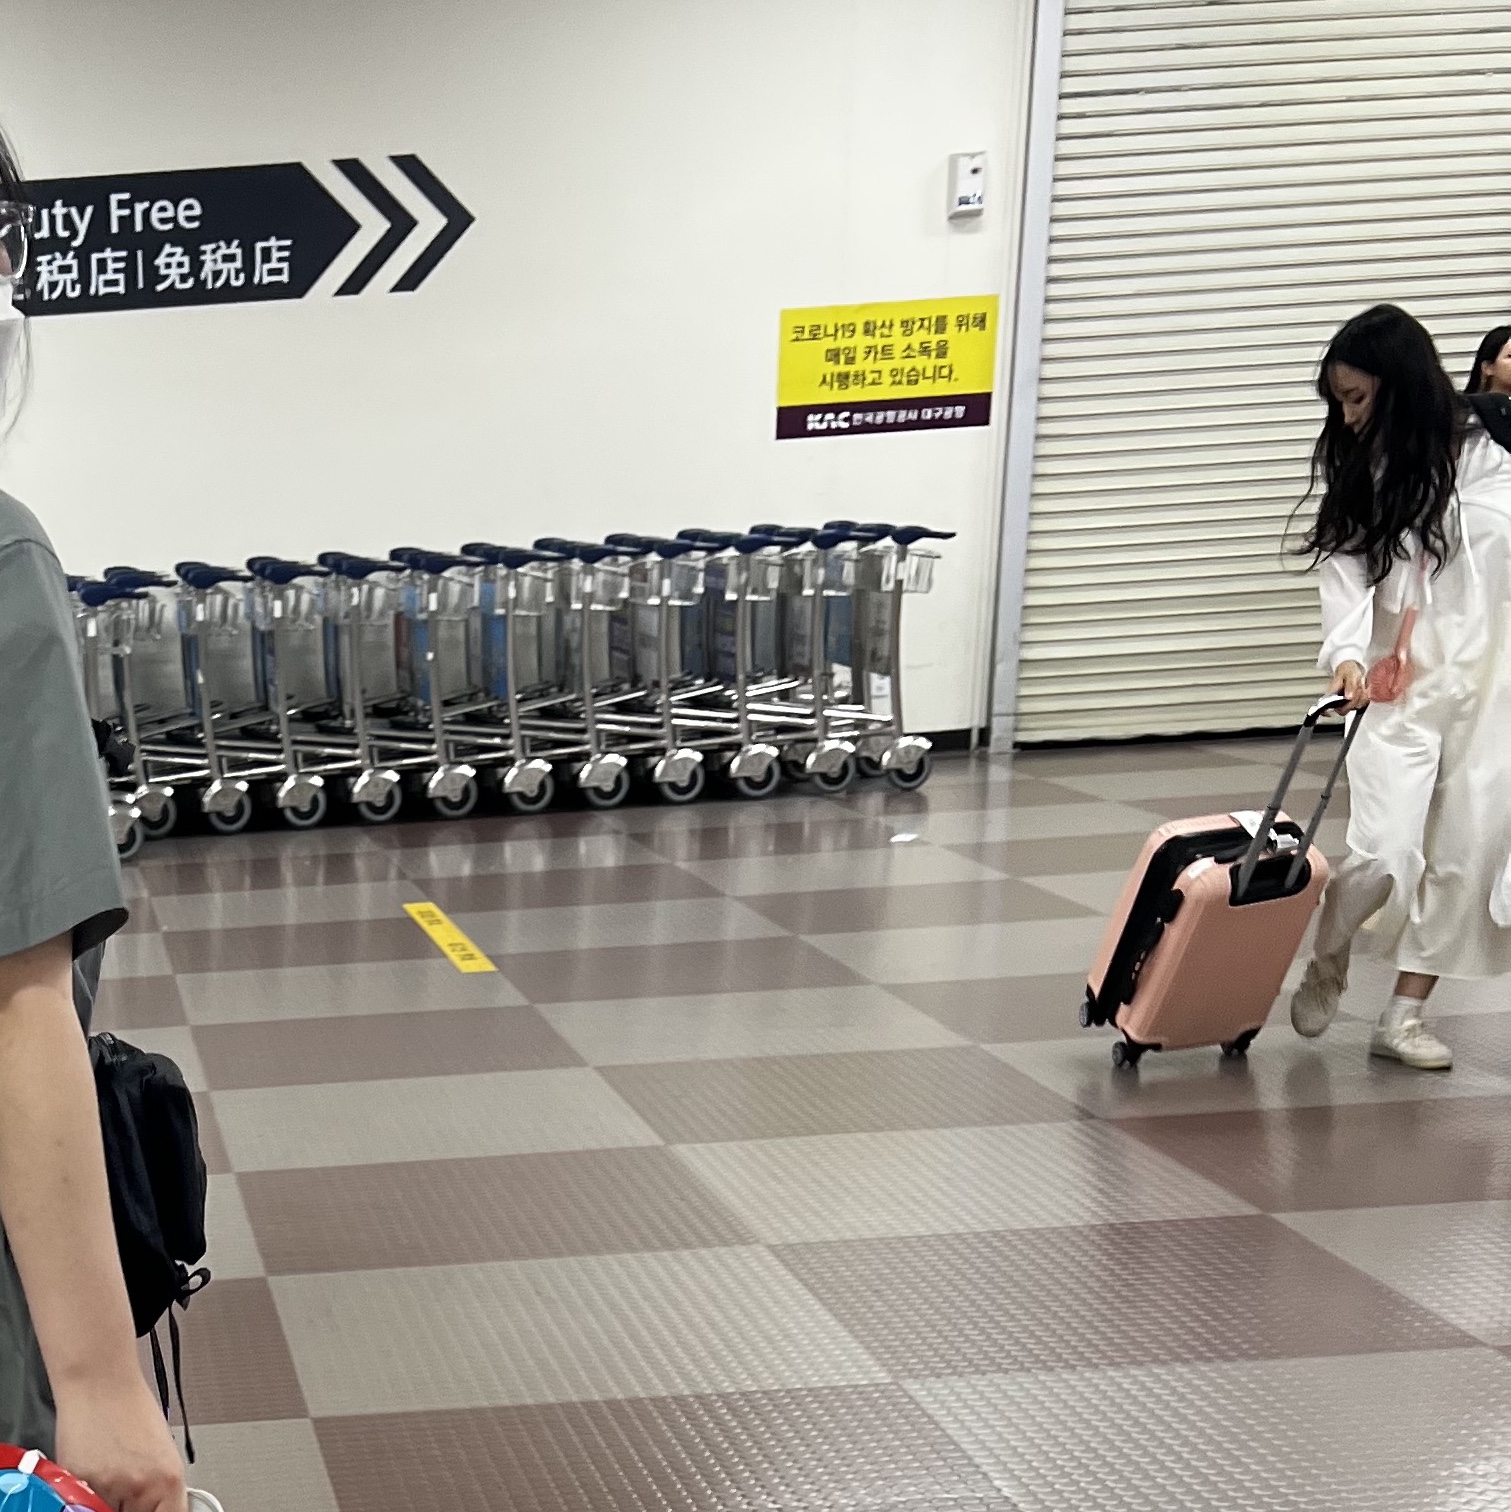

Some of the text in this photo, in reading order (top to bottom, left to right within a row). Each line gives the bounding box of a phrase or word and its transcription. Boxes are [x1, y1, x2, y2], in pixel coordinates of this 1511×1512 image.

[34, 191, 203, 247] uty Free
[790, 312, 988, 343] 코로나19 확산 방지를 위해
[824, 339, 950, 366] 매일 카트 소독을
[818, 363, 960, 391] 시행하고 있습니다.
[806, 411, 851, 431] KAC
